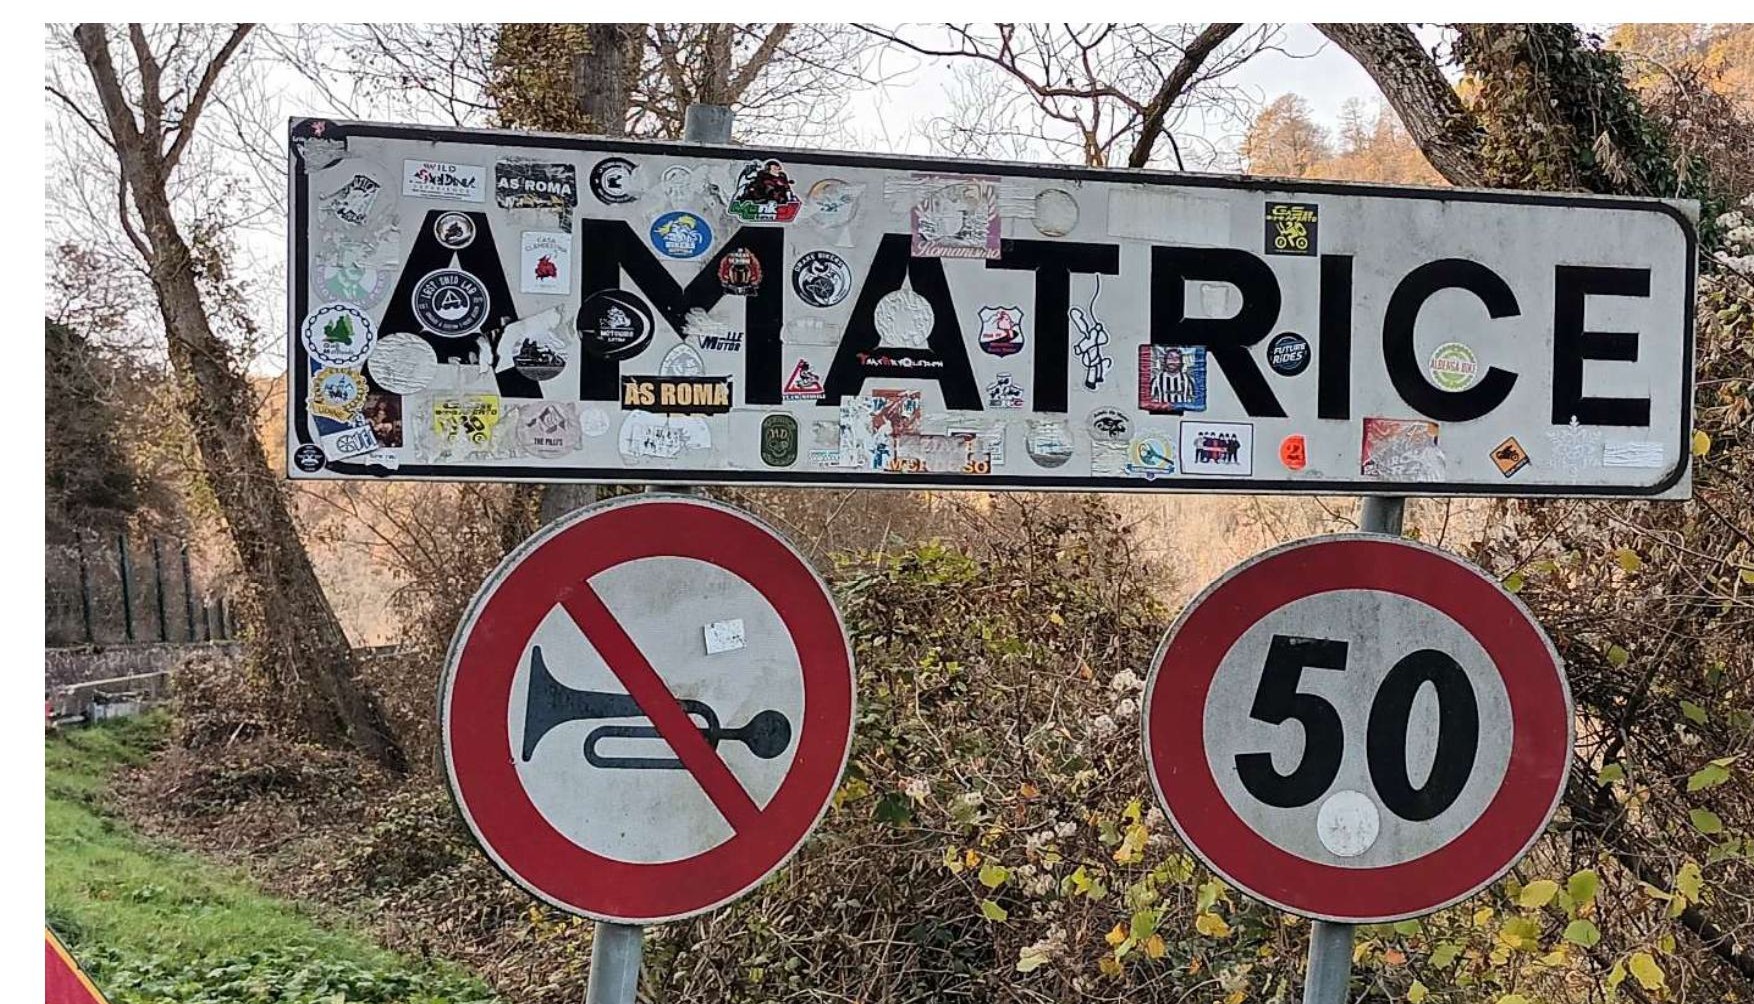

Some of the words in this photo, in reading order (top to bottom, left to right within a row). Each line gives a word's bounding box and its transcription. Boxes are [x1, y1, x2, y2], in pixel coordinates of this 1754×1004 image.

[498, 177, 520, 190] AS
[524, 179, 572, 195] ROMA
[356, 210, 1651, 428] AMATRICE
[624, 382, 656, 406] AS
[661, 382, 729, 406] ROMA
[1234, 633, 1479, 822] 50
